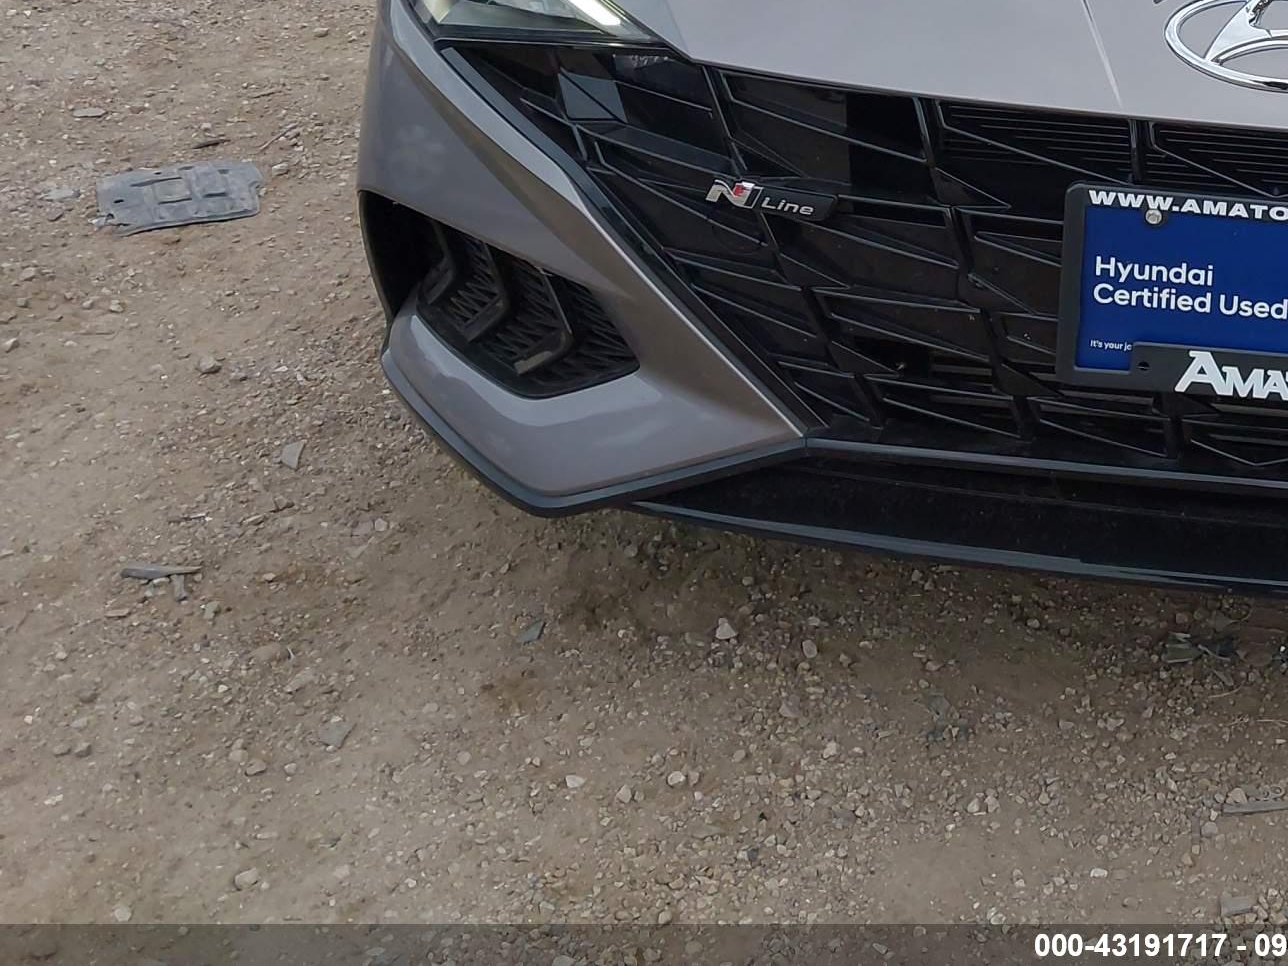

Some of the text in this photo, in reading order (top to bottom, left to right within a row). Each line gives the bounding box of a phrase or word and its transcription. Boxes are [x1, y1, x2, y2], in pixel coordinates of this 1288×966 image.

[761, 197, 814, 215] Line
[1094, 255, 1214, 286] Hyundai
[1093, 283, 1211, 314] Certified
[1219, 295, 1288, 321] Used
[1090, 339, 1103, 349] It's
[1104, 342, 1123, 351] your
